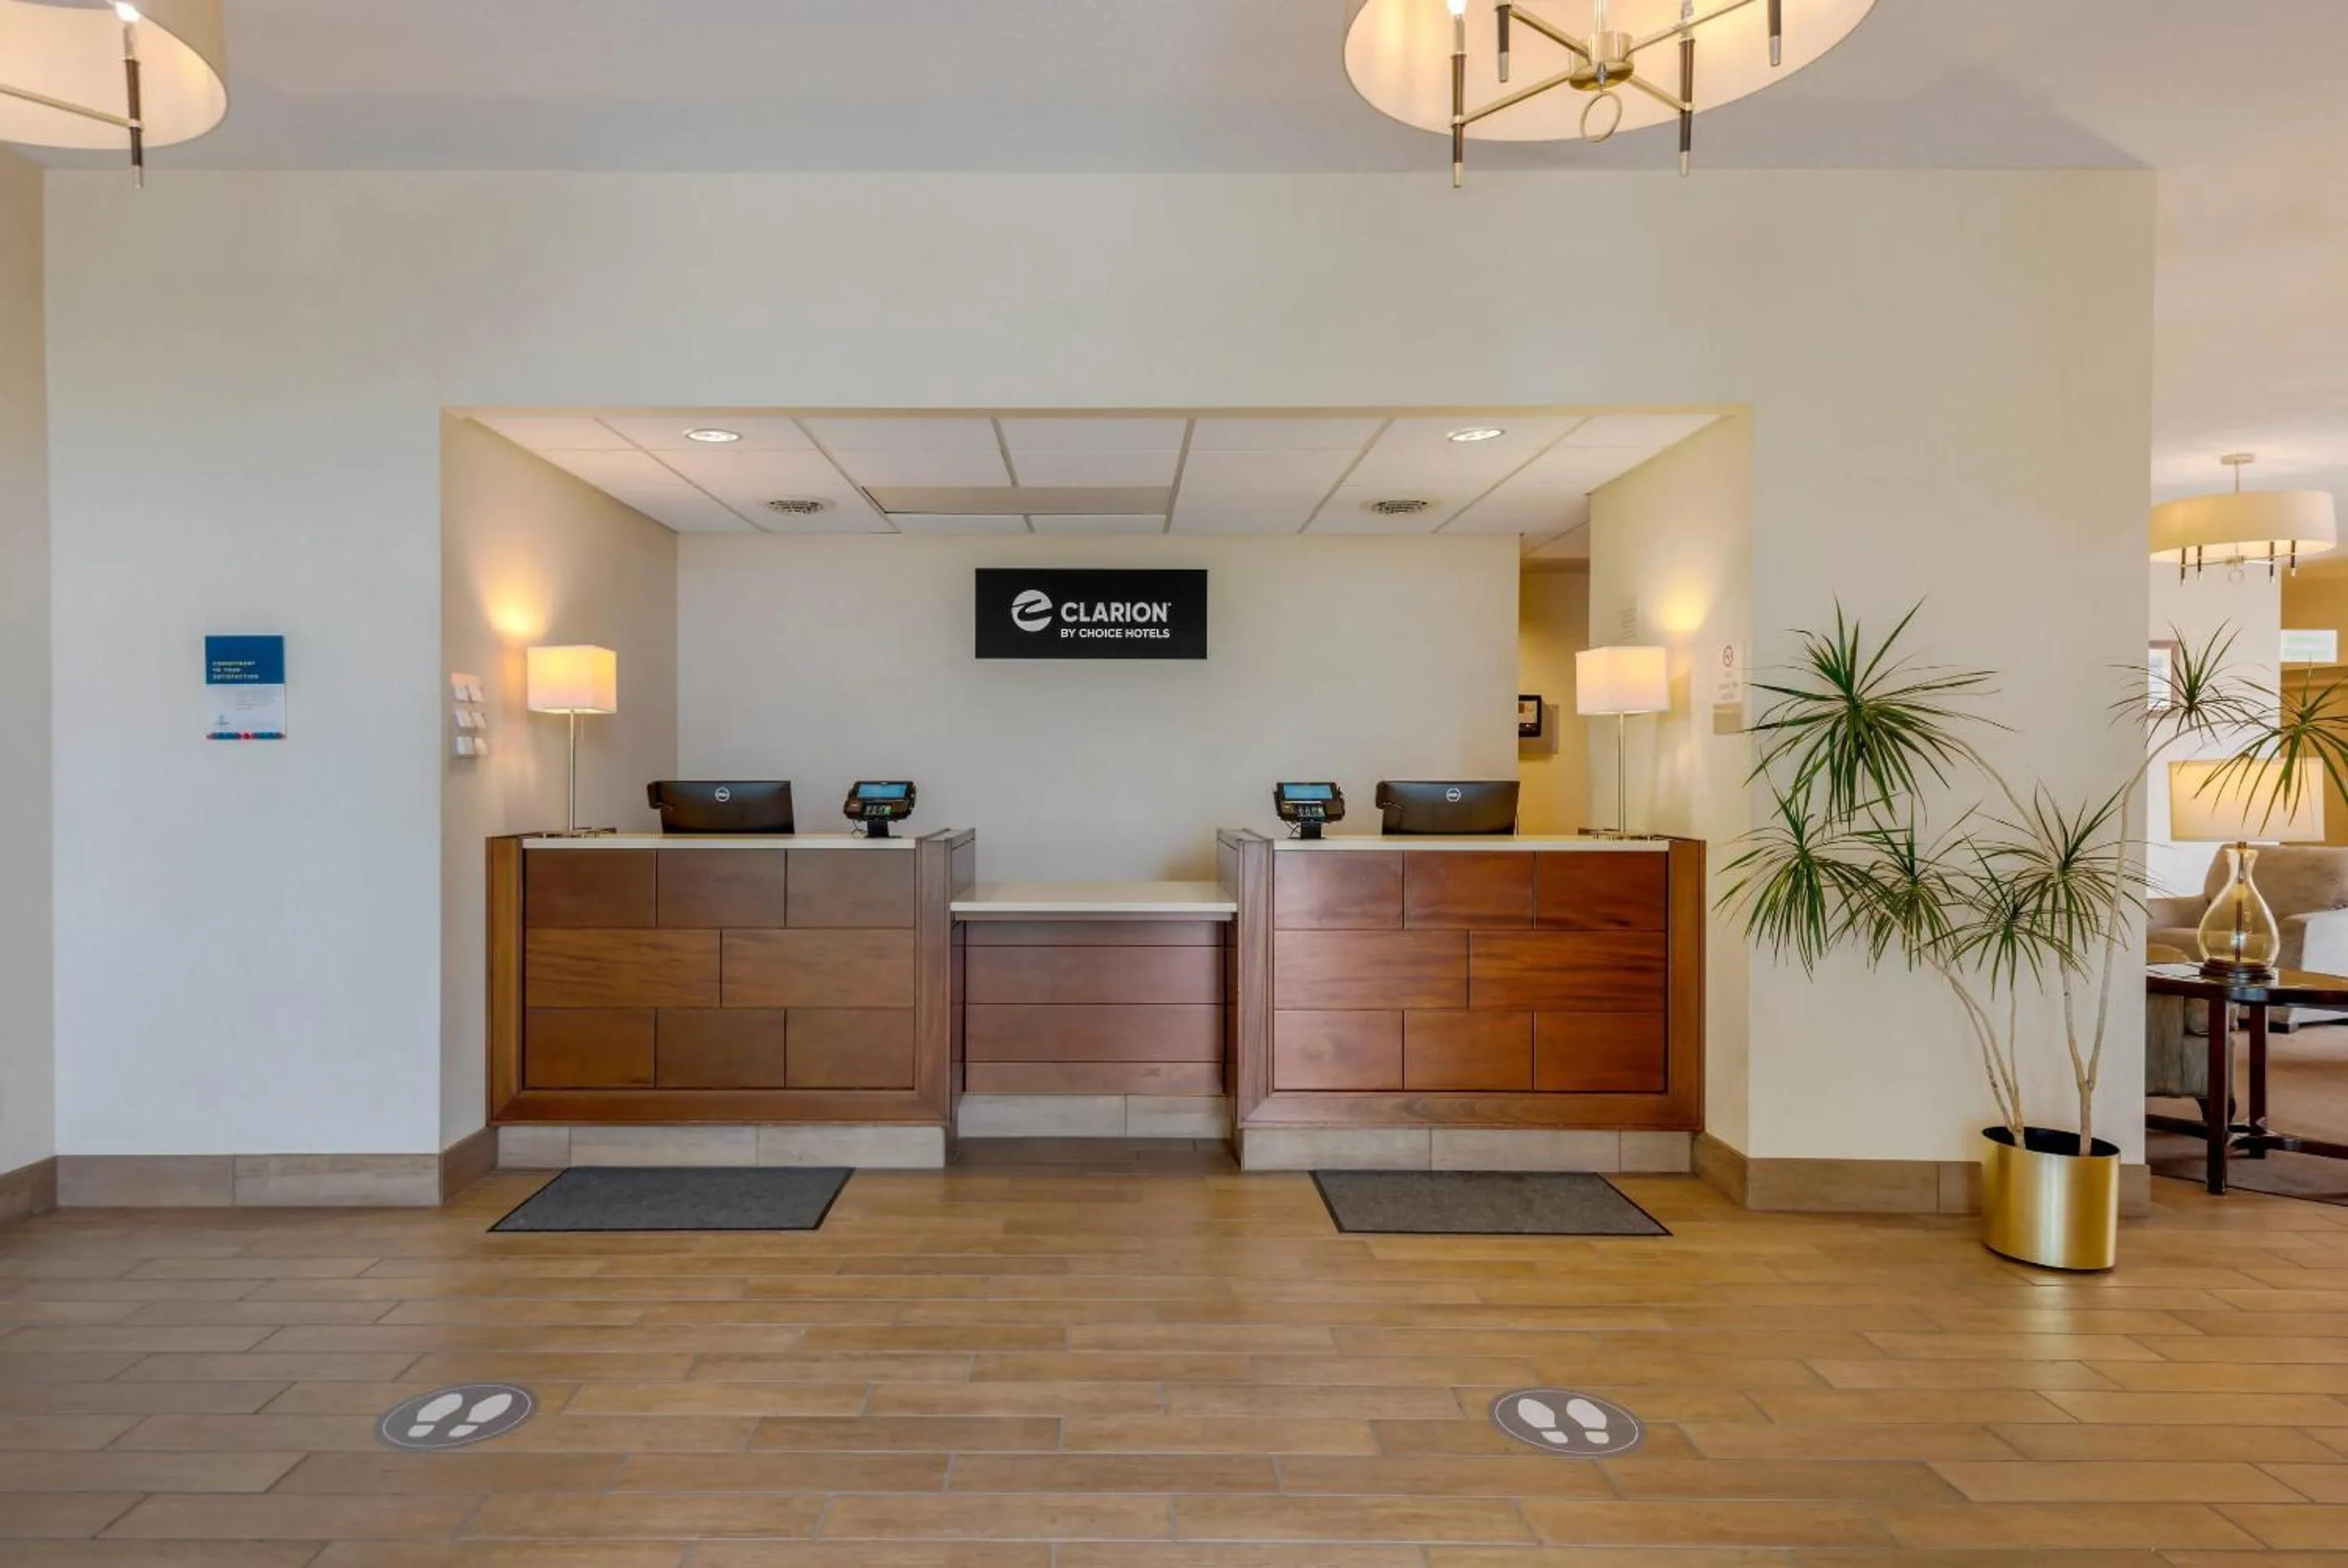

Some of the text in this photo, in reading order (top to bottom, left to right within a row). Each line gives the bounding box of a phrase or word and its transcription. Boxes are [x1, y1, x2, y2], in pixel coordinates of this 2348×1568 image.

[1060, 602, 1168, 622] CLARION
[1060, 629, 1170, 638] BY CHOICE HOTELS
